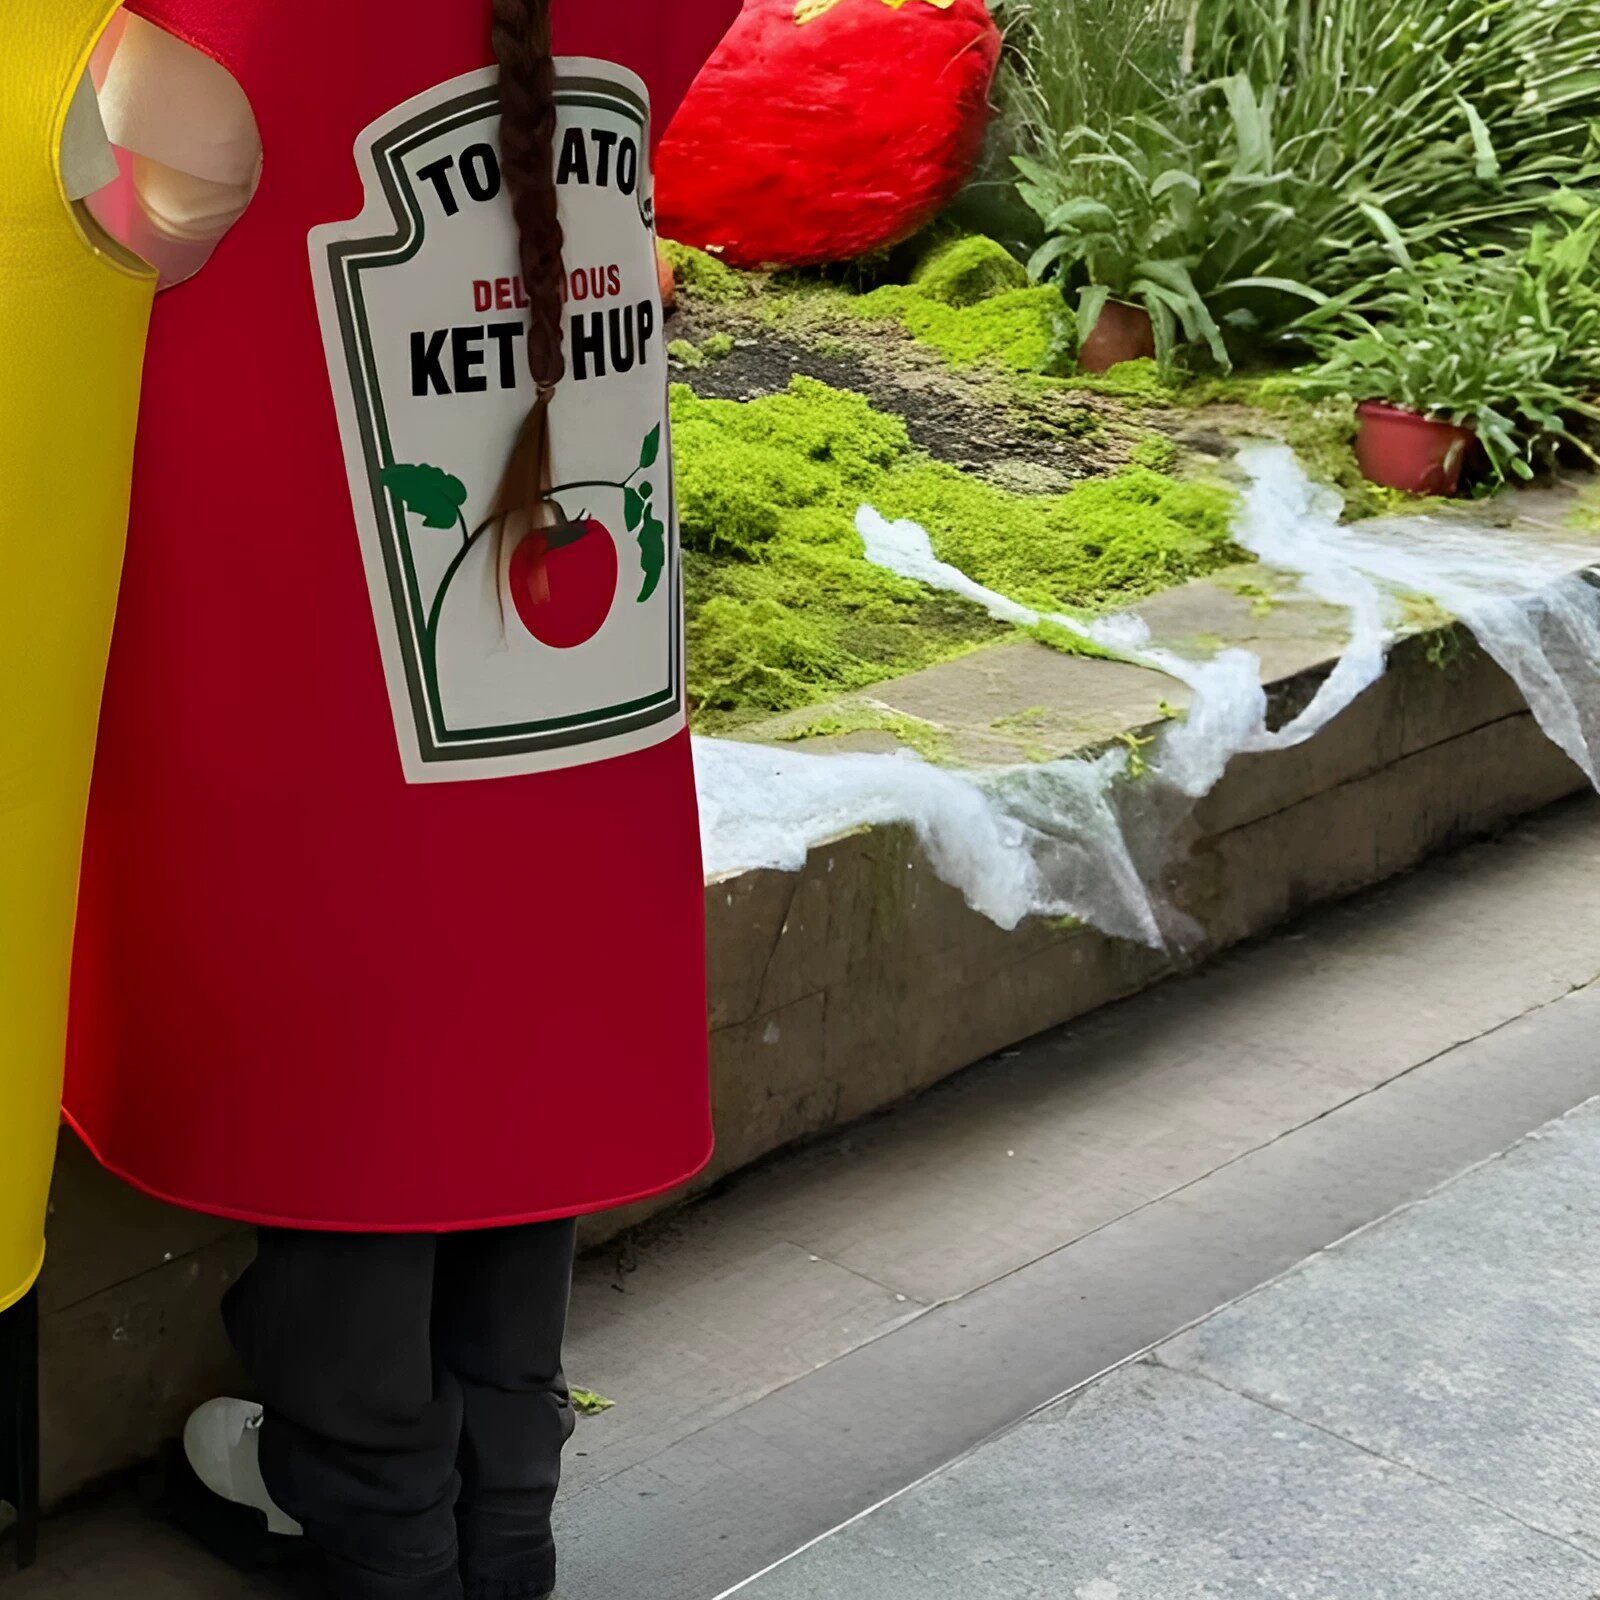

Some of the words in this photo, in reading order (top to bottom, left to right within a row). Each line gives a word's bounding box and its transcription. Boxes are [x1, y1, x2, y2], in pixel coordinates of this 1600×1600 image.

[416, 127, 637, 216] TOATO
[472, 264, 621, 312] DELOUS
[410, 299, 653, 396] KETHUP
